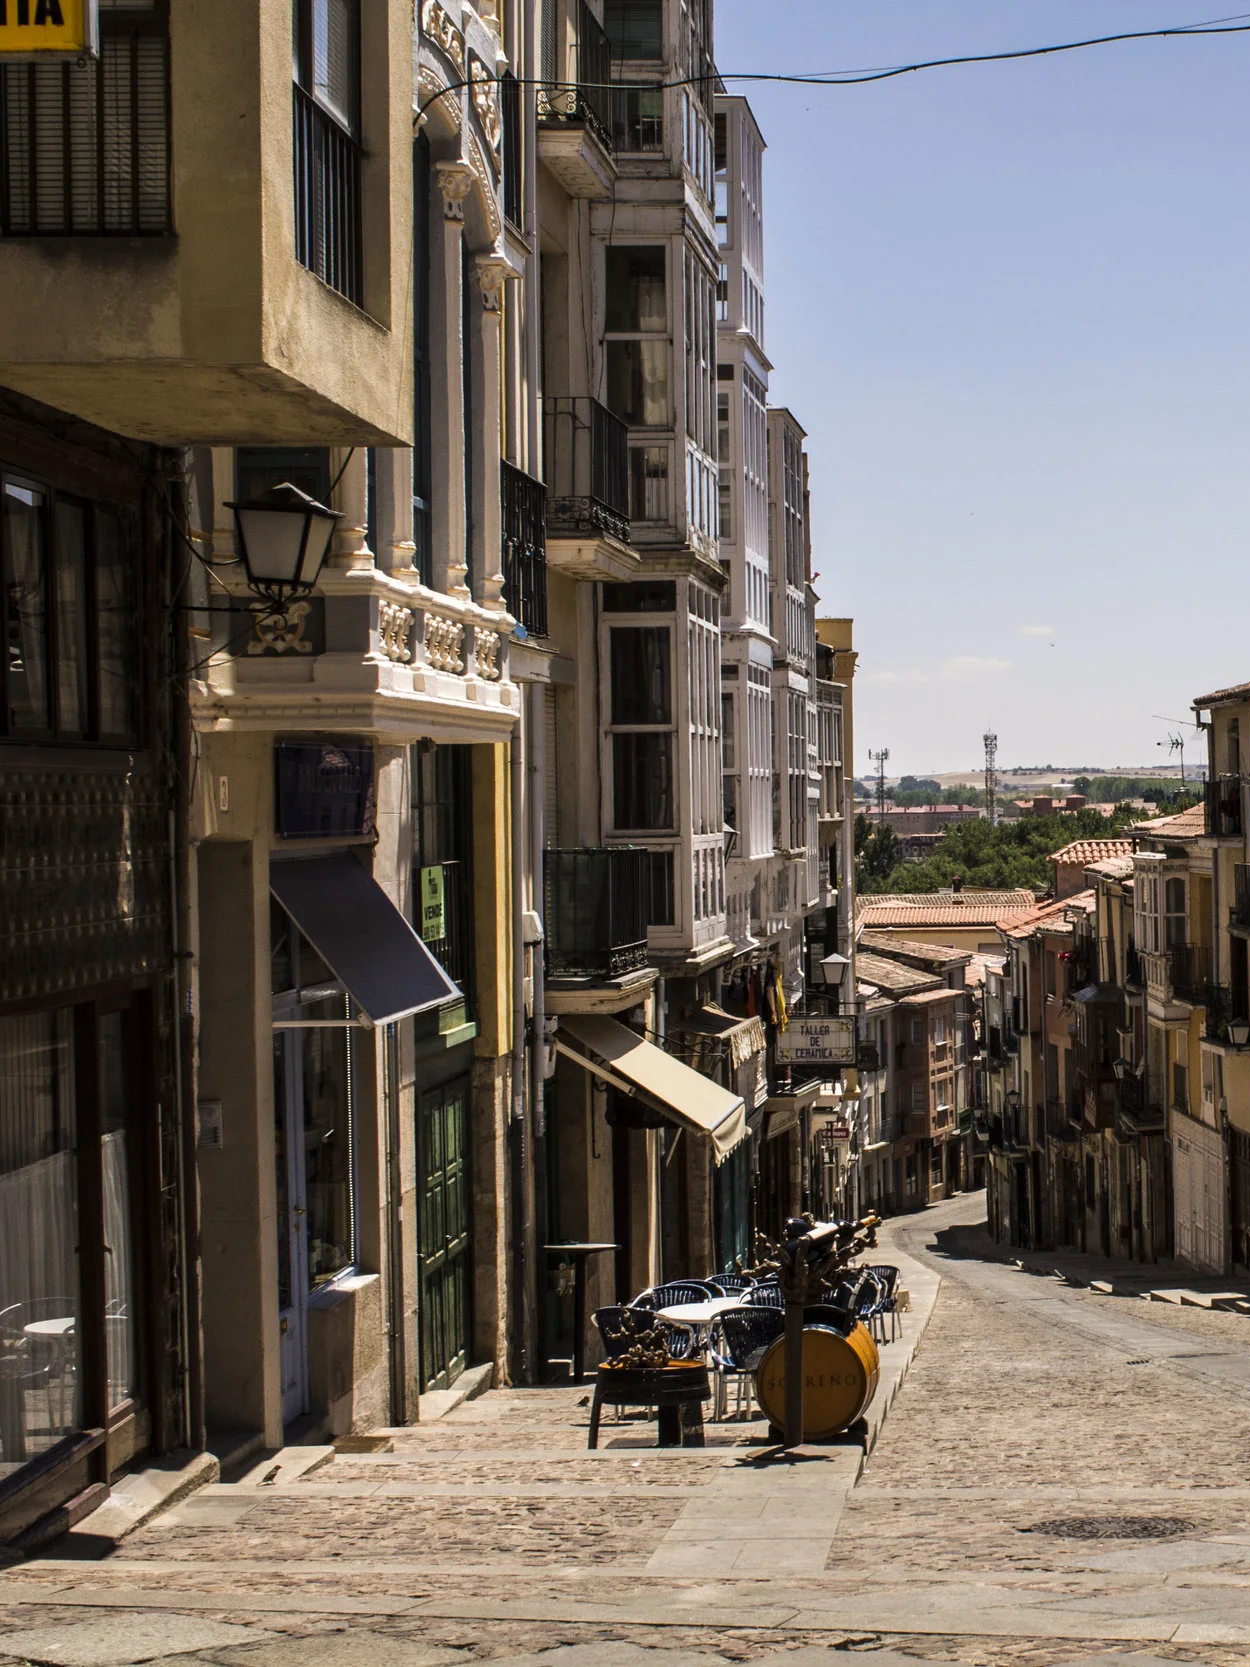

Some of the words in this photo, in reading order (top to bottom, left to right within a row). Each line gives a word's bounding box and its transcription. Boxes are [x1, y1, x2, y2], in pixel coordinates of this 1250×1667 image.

[424, 903, 443, 921] VENDE
[800, 1025, 830, 1036] TALLER
[810, 1037, 821, 1047] DE
[768, 1373, 857, 1391] SOREÑO
